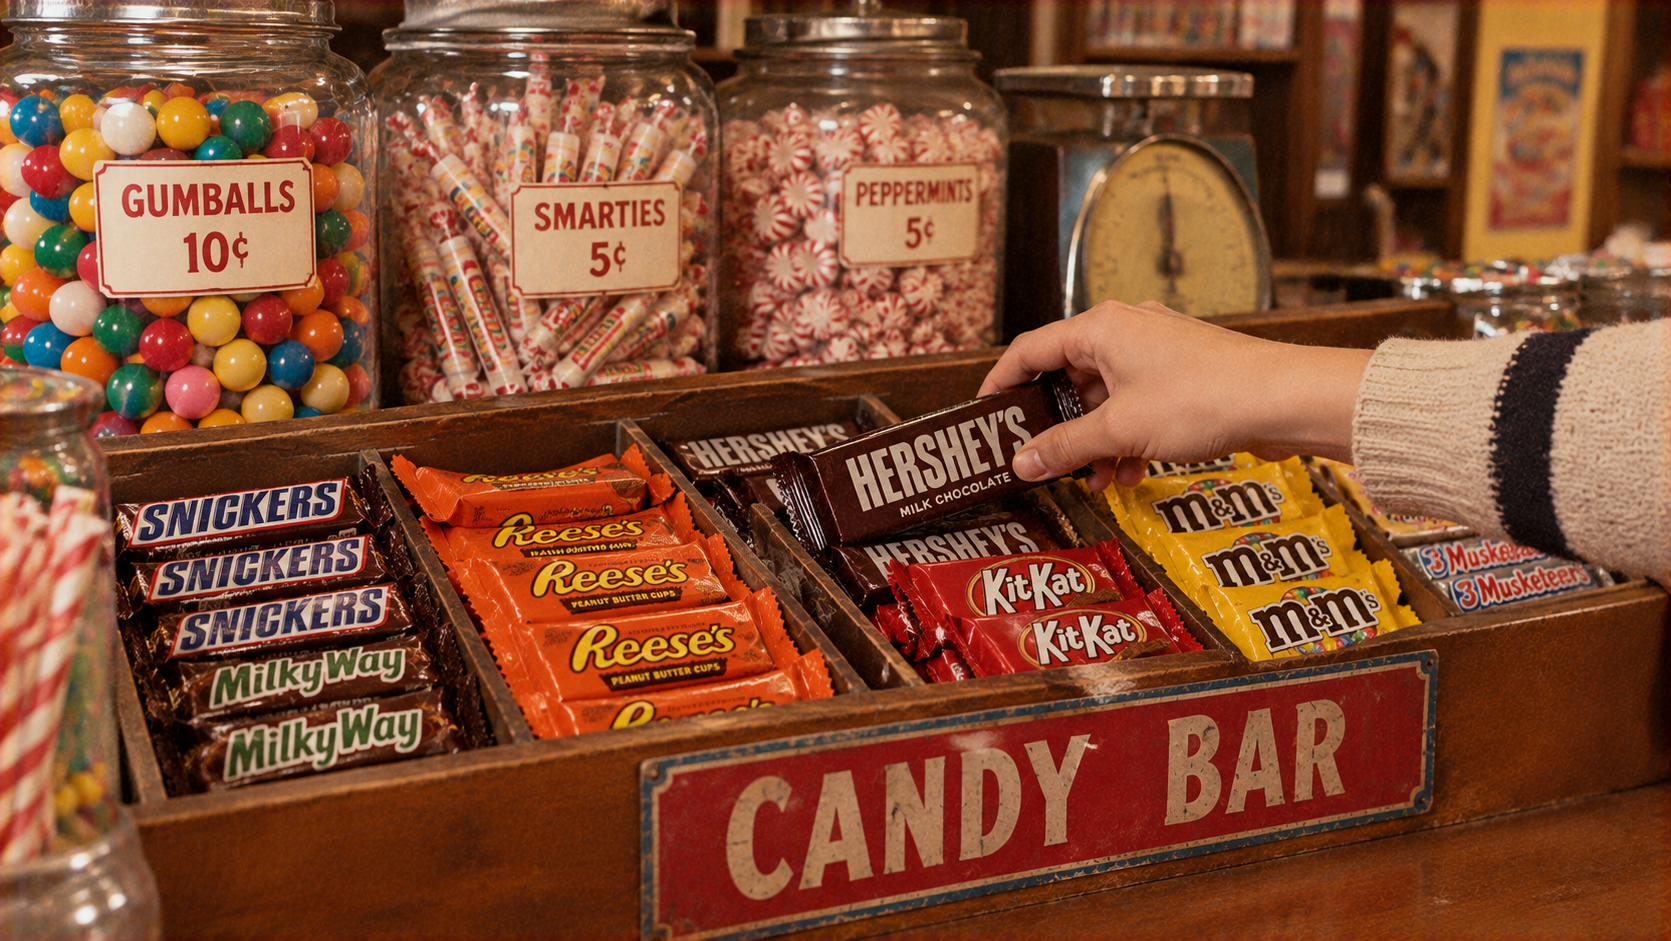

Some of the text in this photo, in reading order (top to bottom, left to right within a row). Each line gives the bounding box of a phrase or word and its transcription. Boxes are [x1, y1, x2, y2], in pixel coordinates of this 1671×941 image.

[121, 179, 296, 218] GUMBALLS
[855, 178, 974, 207] PEPPERMINTS
[534, 198, 666, 232] SMARTIES
[903, 215, 935, 250] 5¢
[183, 230, 249, 273] 10¢
[589, 240, 627, 278] 5¢
[844, 405, 1034, 513] HERSHEY'S
[138, 483, 338, 542] SNICKERS
[899, 471, 1012, 518] MILK CHOCOLATE
[493, 512, 646, 548] Reese's
[157, 539, 360, 597] SNICKERS
[531, 560, 689, 598] Reese's
[1456, 567, 1590, 608] 3 Musketeers
[650, 590, 677, 599] CUPS
[180, 588, 383, 651] SNICKERS
[570, 623, 736, 673] Reese's
[611, 662, 721, 686] PEANUT BUTTER CUPS
[724, 698, 1346, 902] CANDY BAR
